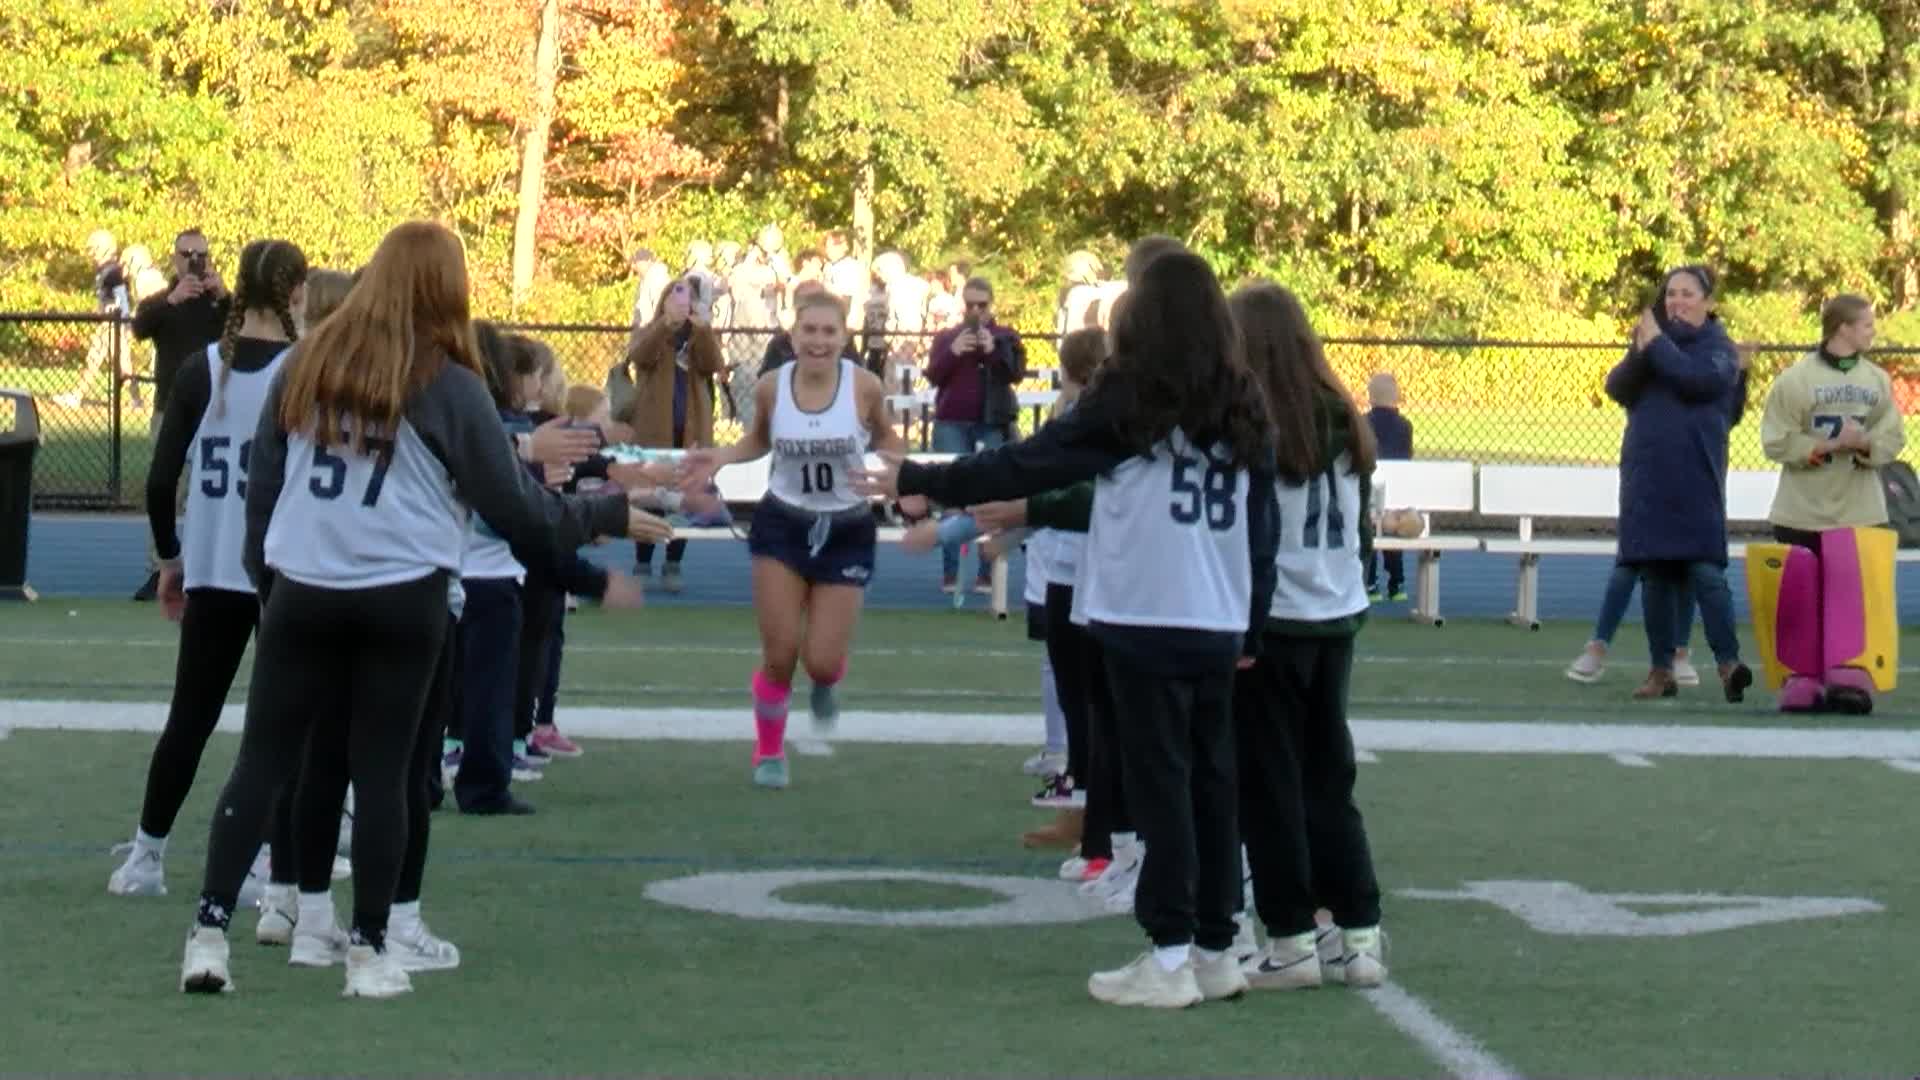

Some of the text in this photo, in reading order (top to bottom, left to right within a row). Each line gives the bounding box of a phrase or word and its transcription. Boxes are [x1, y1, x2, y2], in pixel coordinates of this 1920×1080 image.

[309, 437, 396, 508] 57
[801, 462, 834, 494] 10
[1169, 455, 1237, 532] 58
